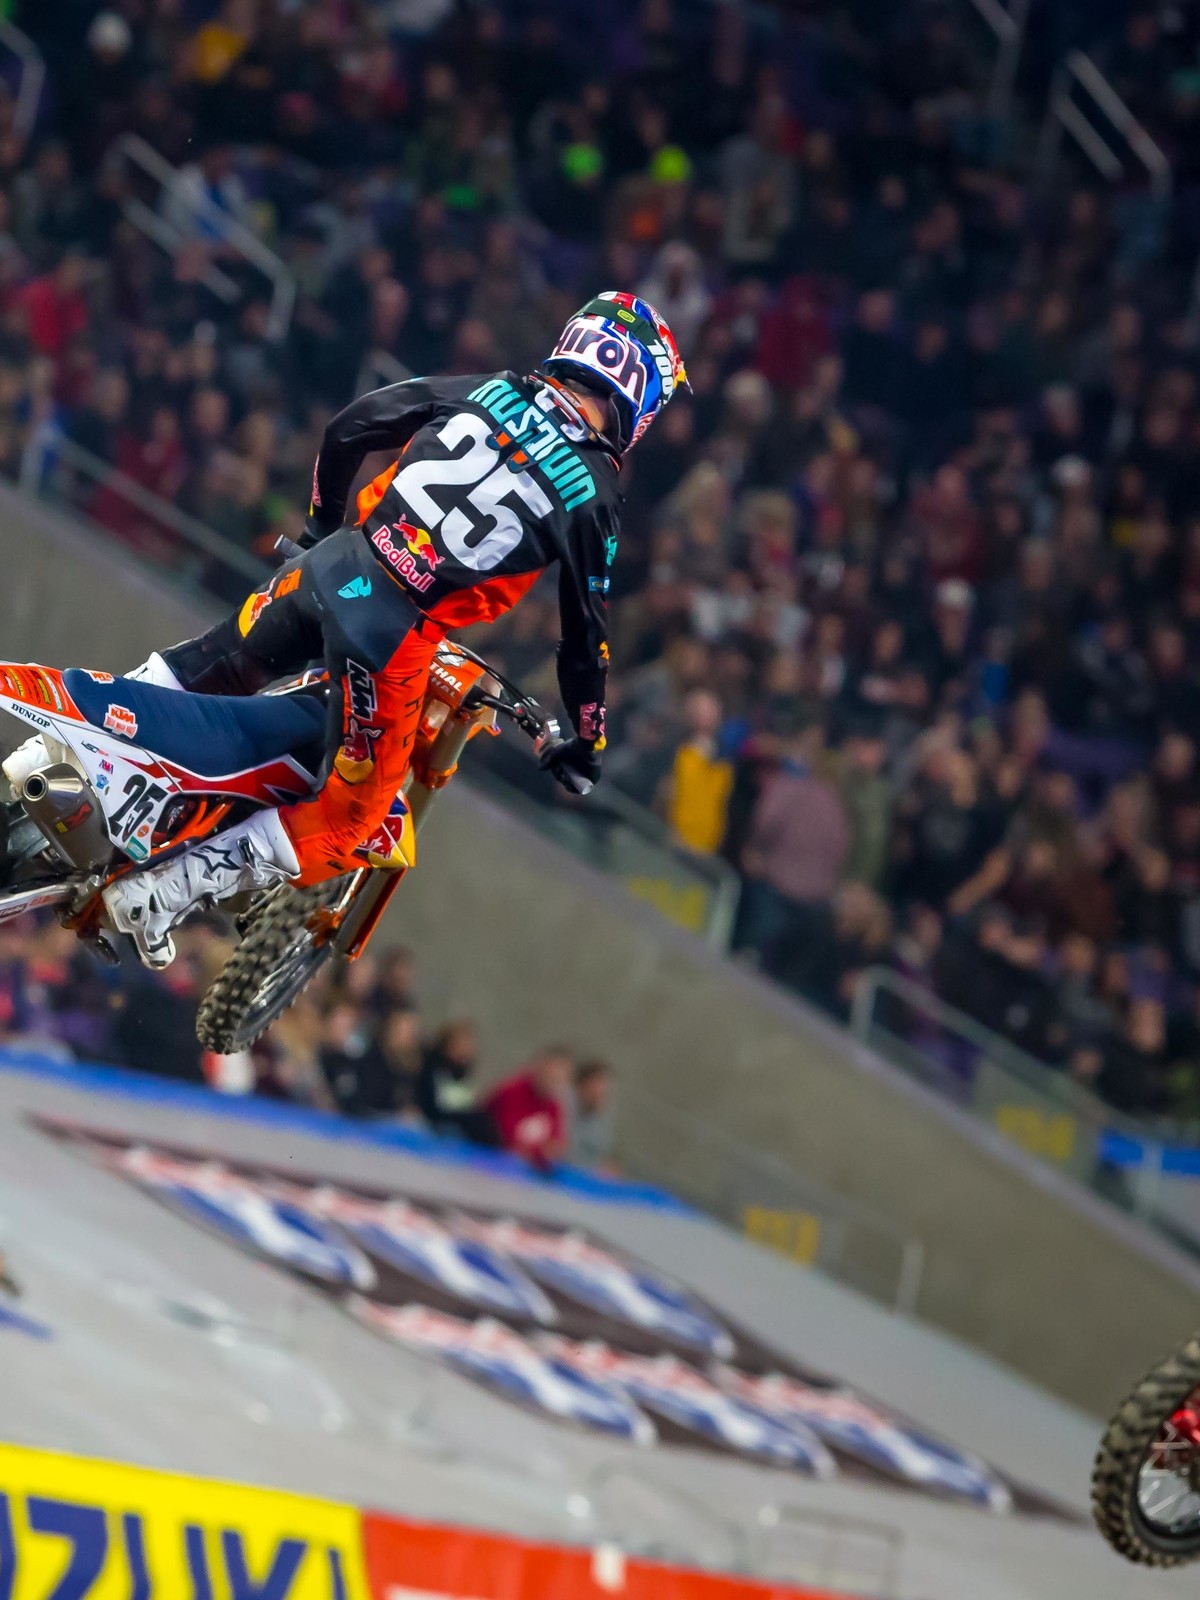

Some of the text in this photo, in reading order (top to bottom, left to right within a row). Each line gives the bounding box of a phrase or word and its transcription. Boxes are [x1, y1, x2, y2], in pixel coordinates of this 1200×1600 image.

[392, 413, 554, 571] 25
[11, 702, 51, 729] DUNLOP
[110, 705, 135, 724] KTM
[108, 774, 169, 842] 25
